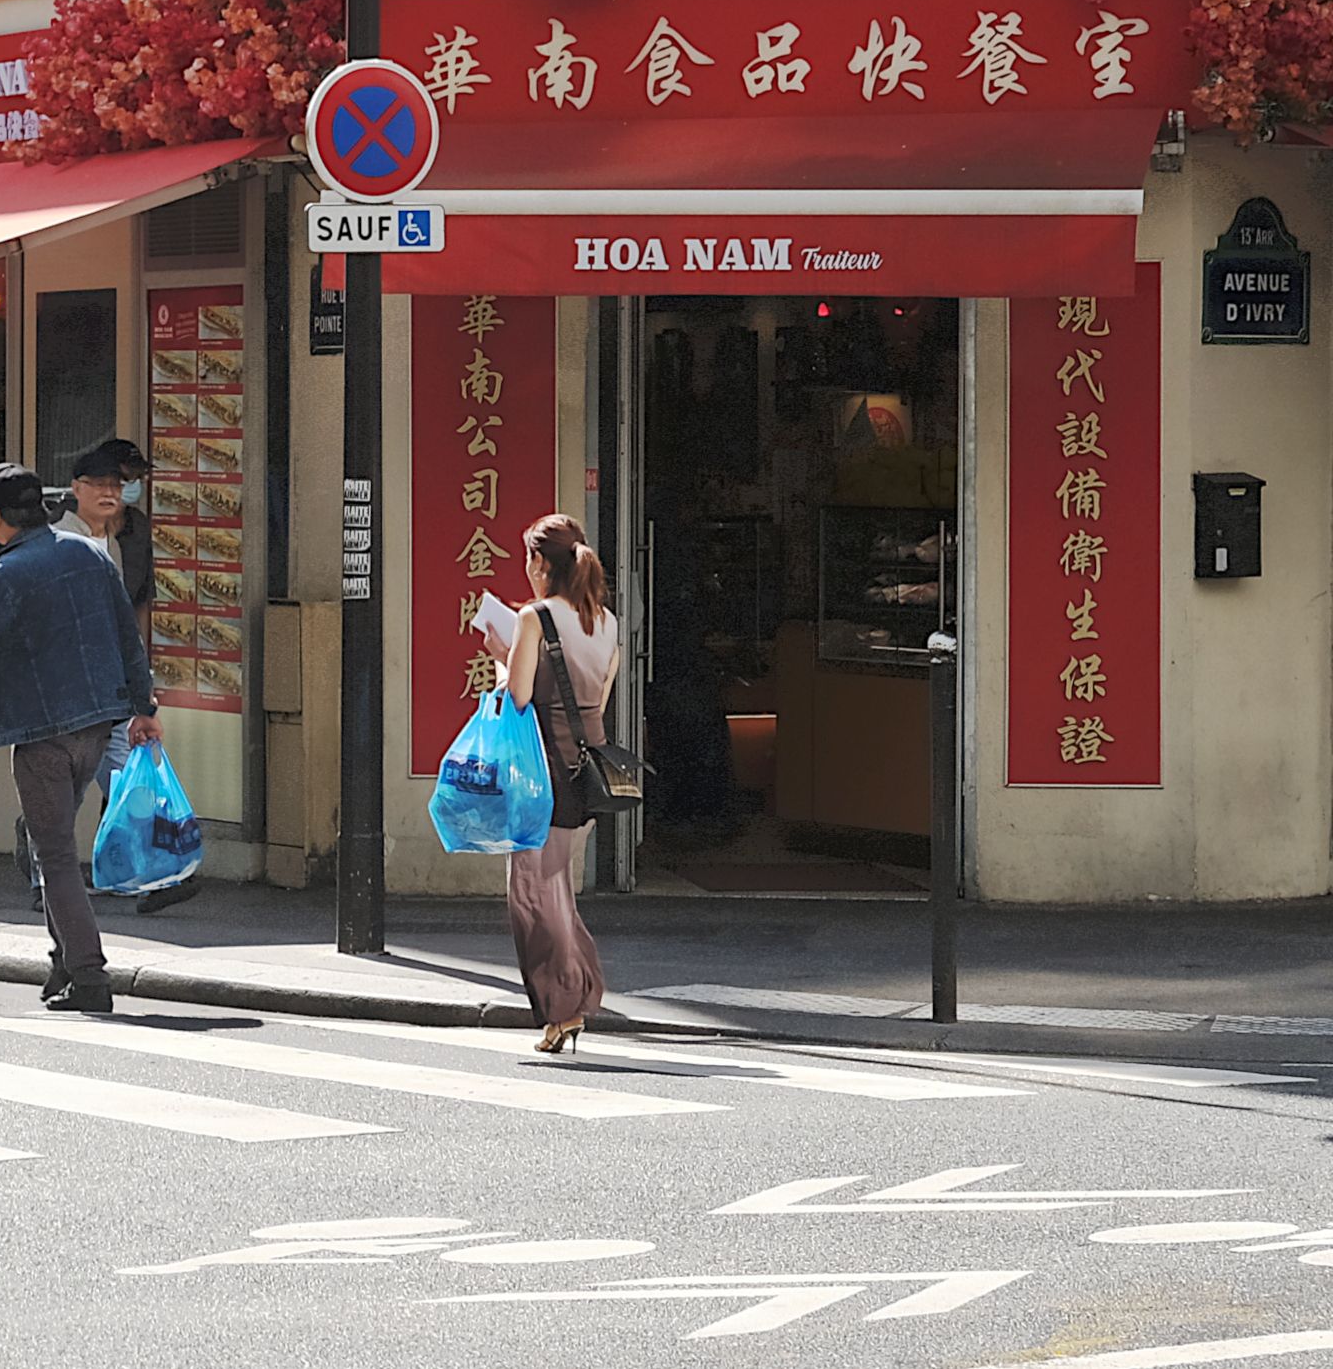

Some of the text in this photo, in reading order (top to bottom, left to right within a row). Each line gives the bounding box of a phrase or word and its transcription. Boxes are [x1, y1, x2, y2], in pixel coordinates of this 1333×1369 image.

[423, 9, 1150, 115] 華南食品快餐室
[317, 215, 392, 242] SAUF
[573, 237, 884, 273] HOA NAM Traiteur
[1223, 272, 1291, 292] AVENUE
[314, 314, 343, 333] POINTE
[1225, 302, 1287, 323] D'IVRY
